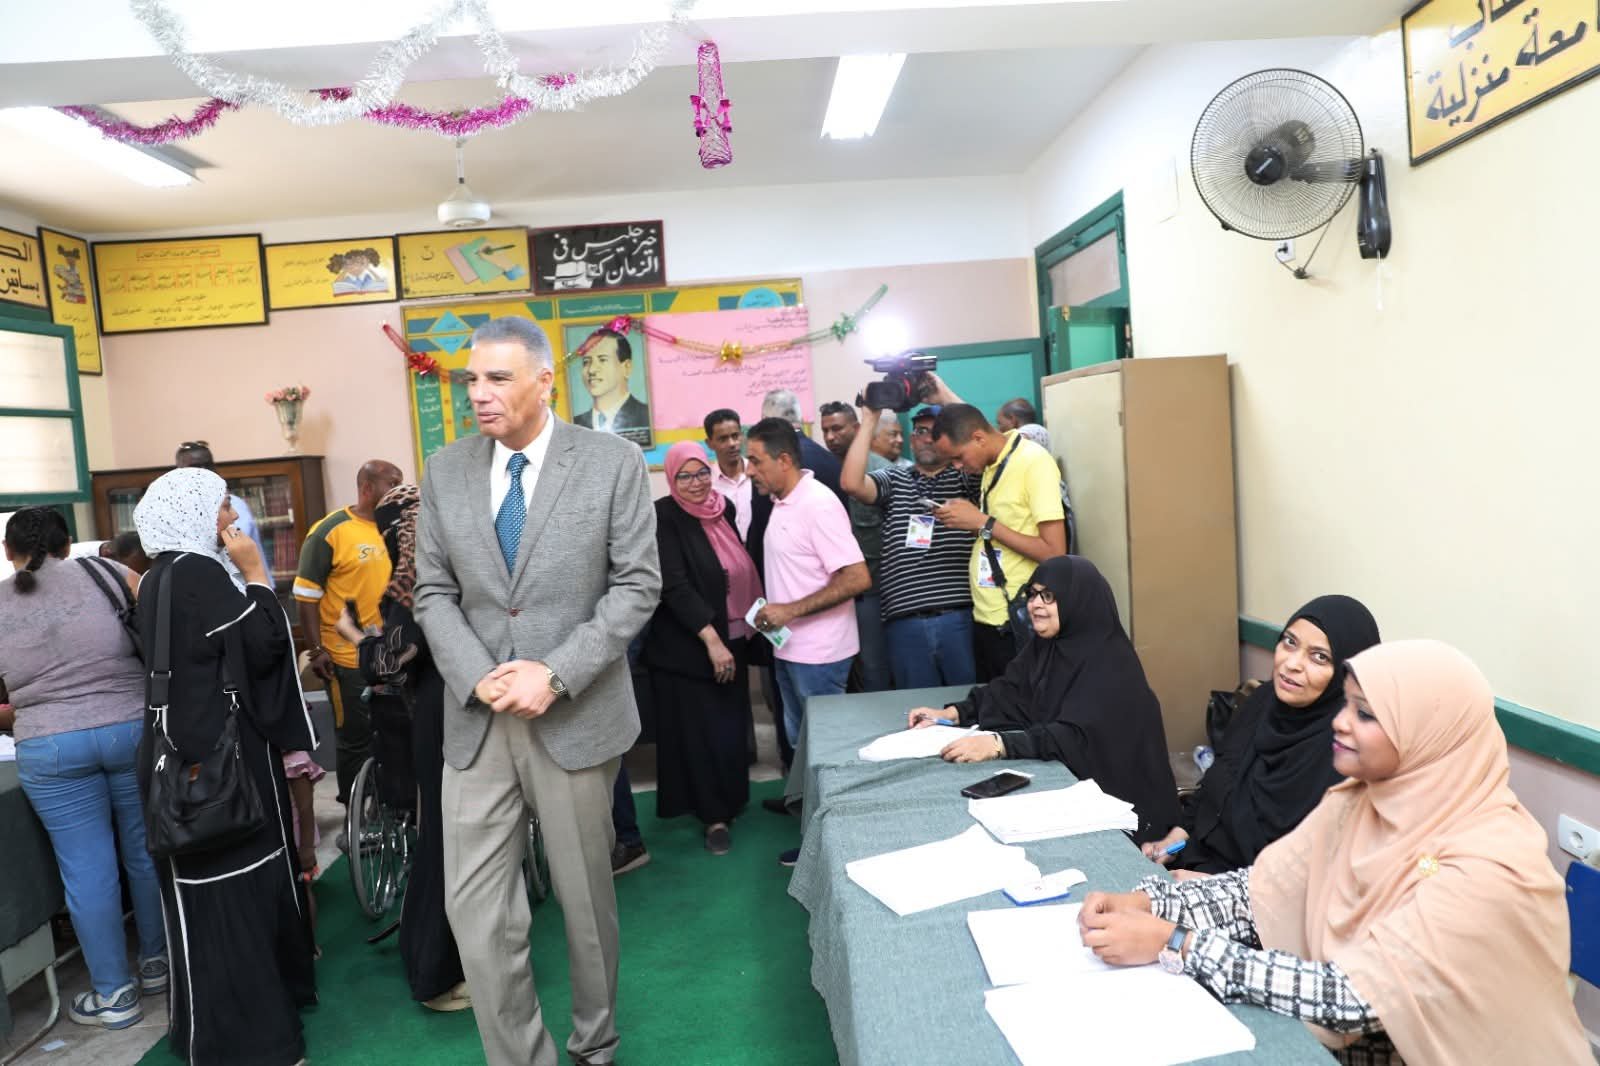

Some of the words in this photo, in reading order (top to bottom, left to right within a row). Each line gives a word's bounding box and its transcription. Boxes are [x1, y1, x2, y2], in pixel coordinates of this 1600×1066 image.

[1426, 53, 1510, 127] منزلية
[571, 224, 644, 260] جليس
[631, 229, 657, 256] خير
[606, 255, 659, 284] الزمان
